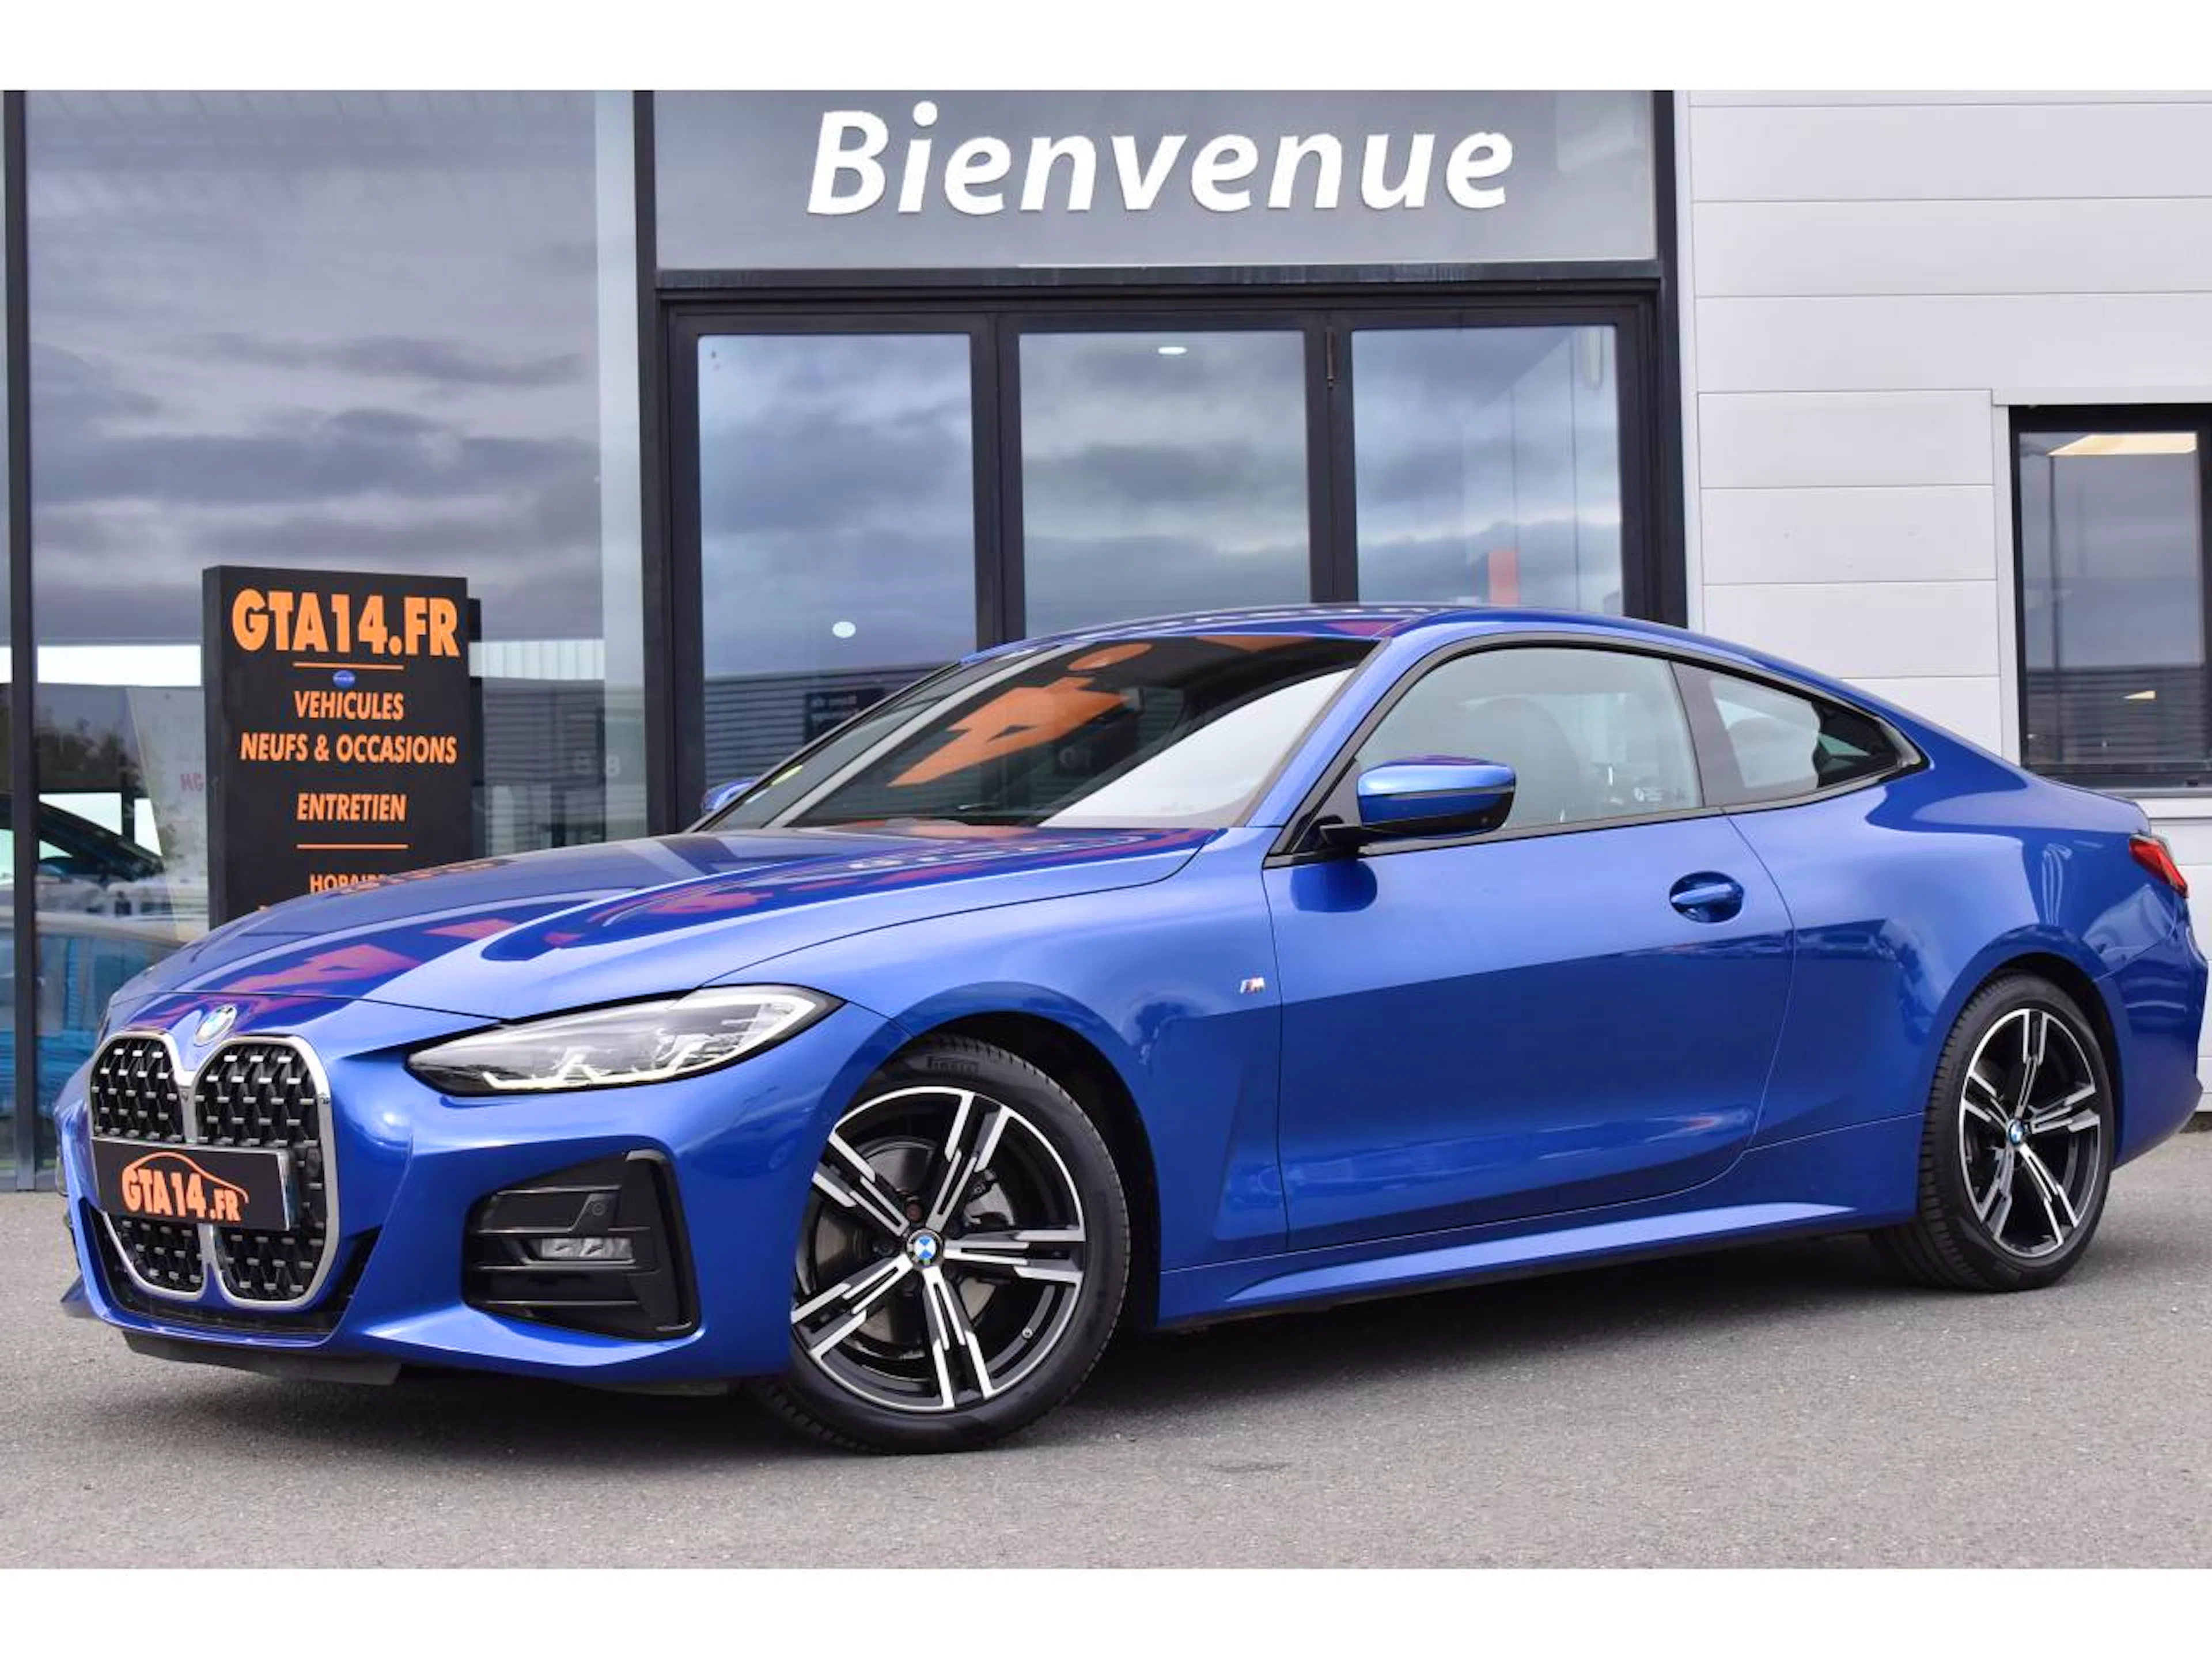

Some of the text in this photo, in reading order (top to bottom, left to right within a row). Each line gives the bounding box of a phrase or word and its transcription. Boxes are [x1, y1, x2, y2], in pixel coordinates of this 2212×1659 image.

[807, 101, 1513, 215] Bienvenue
[231, 588, 460, 658] GTA14.FR
[294, 690, 405, 721] VEHICULES
[239, 731, 459, 765] NEUFS & OCCASIONS
[296, 792, 408, 823] ENTRETIEN
[122, 1167, 241, 1222] GTA14.FR
